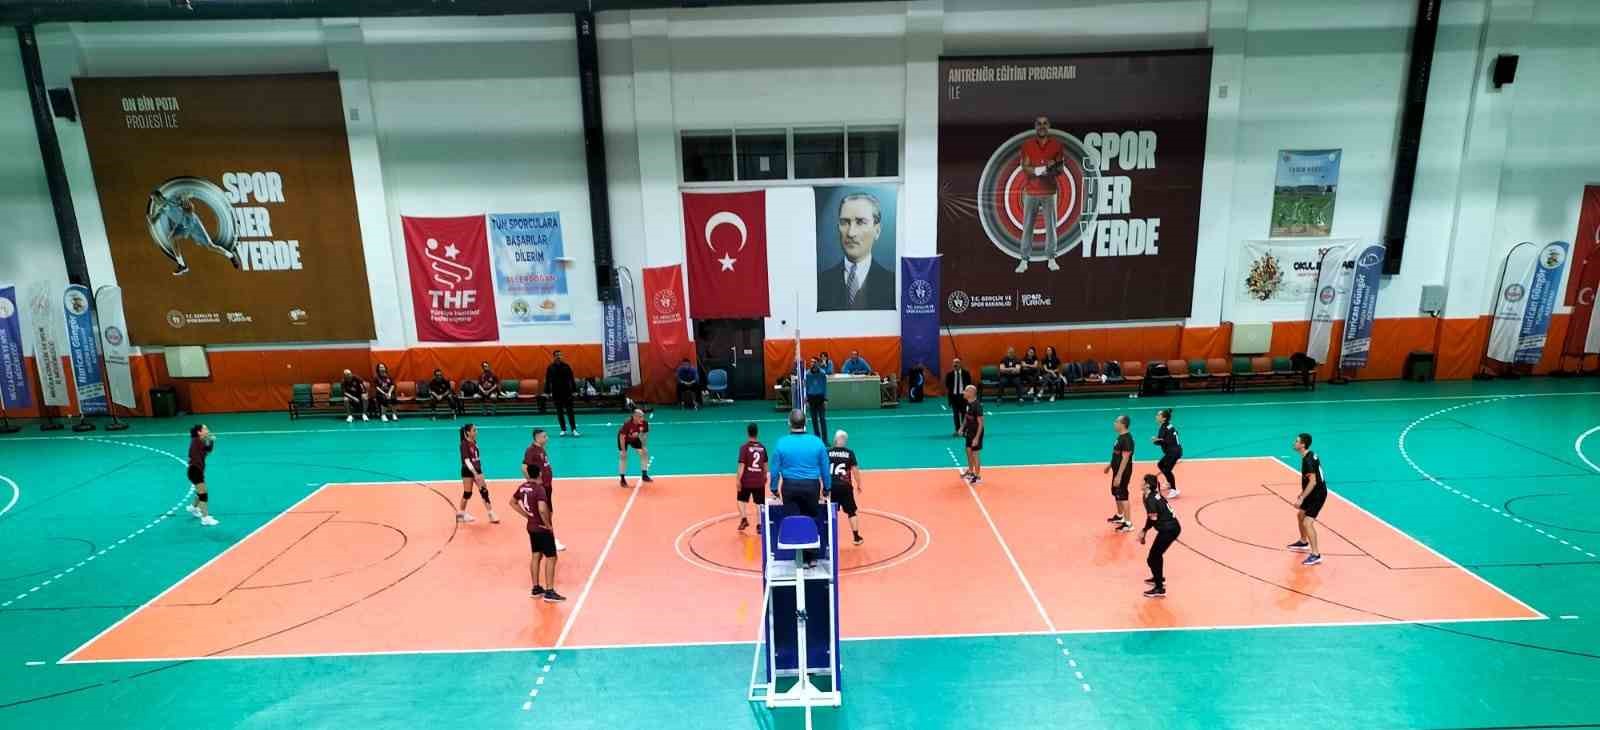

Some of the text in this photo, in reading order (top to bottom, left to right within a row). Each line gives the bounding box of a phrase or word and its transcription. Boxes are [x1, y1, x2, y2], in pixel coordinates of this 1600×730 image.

[948, 65, 1077, 82] ANTRENÖR EĞİTİM PROGRAMI
[122, 95, 180, 111] ON BİN POTA
[126, 112, 164, 129] PROJESİ
[1083, 130, 1157, 172] SPOR
[222, 171, 286, 204] SPOR
[1080, 175, 1132, 215] HER
[232, 206, 273, 238] HER
[509, 216, 559, 230] SPORCULARA
[505, 234, 550, 247] BAŞARILAR
[1080, 218, 1161, 258] YERDE
[236, 240, 303, 272] YERDE
[515, 250, 544, 262] DİLERİM
[428, 290, 477, 308] THF
[752, 451, 761, 467] 2
